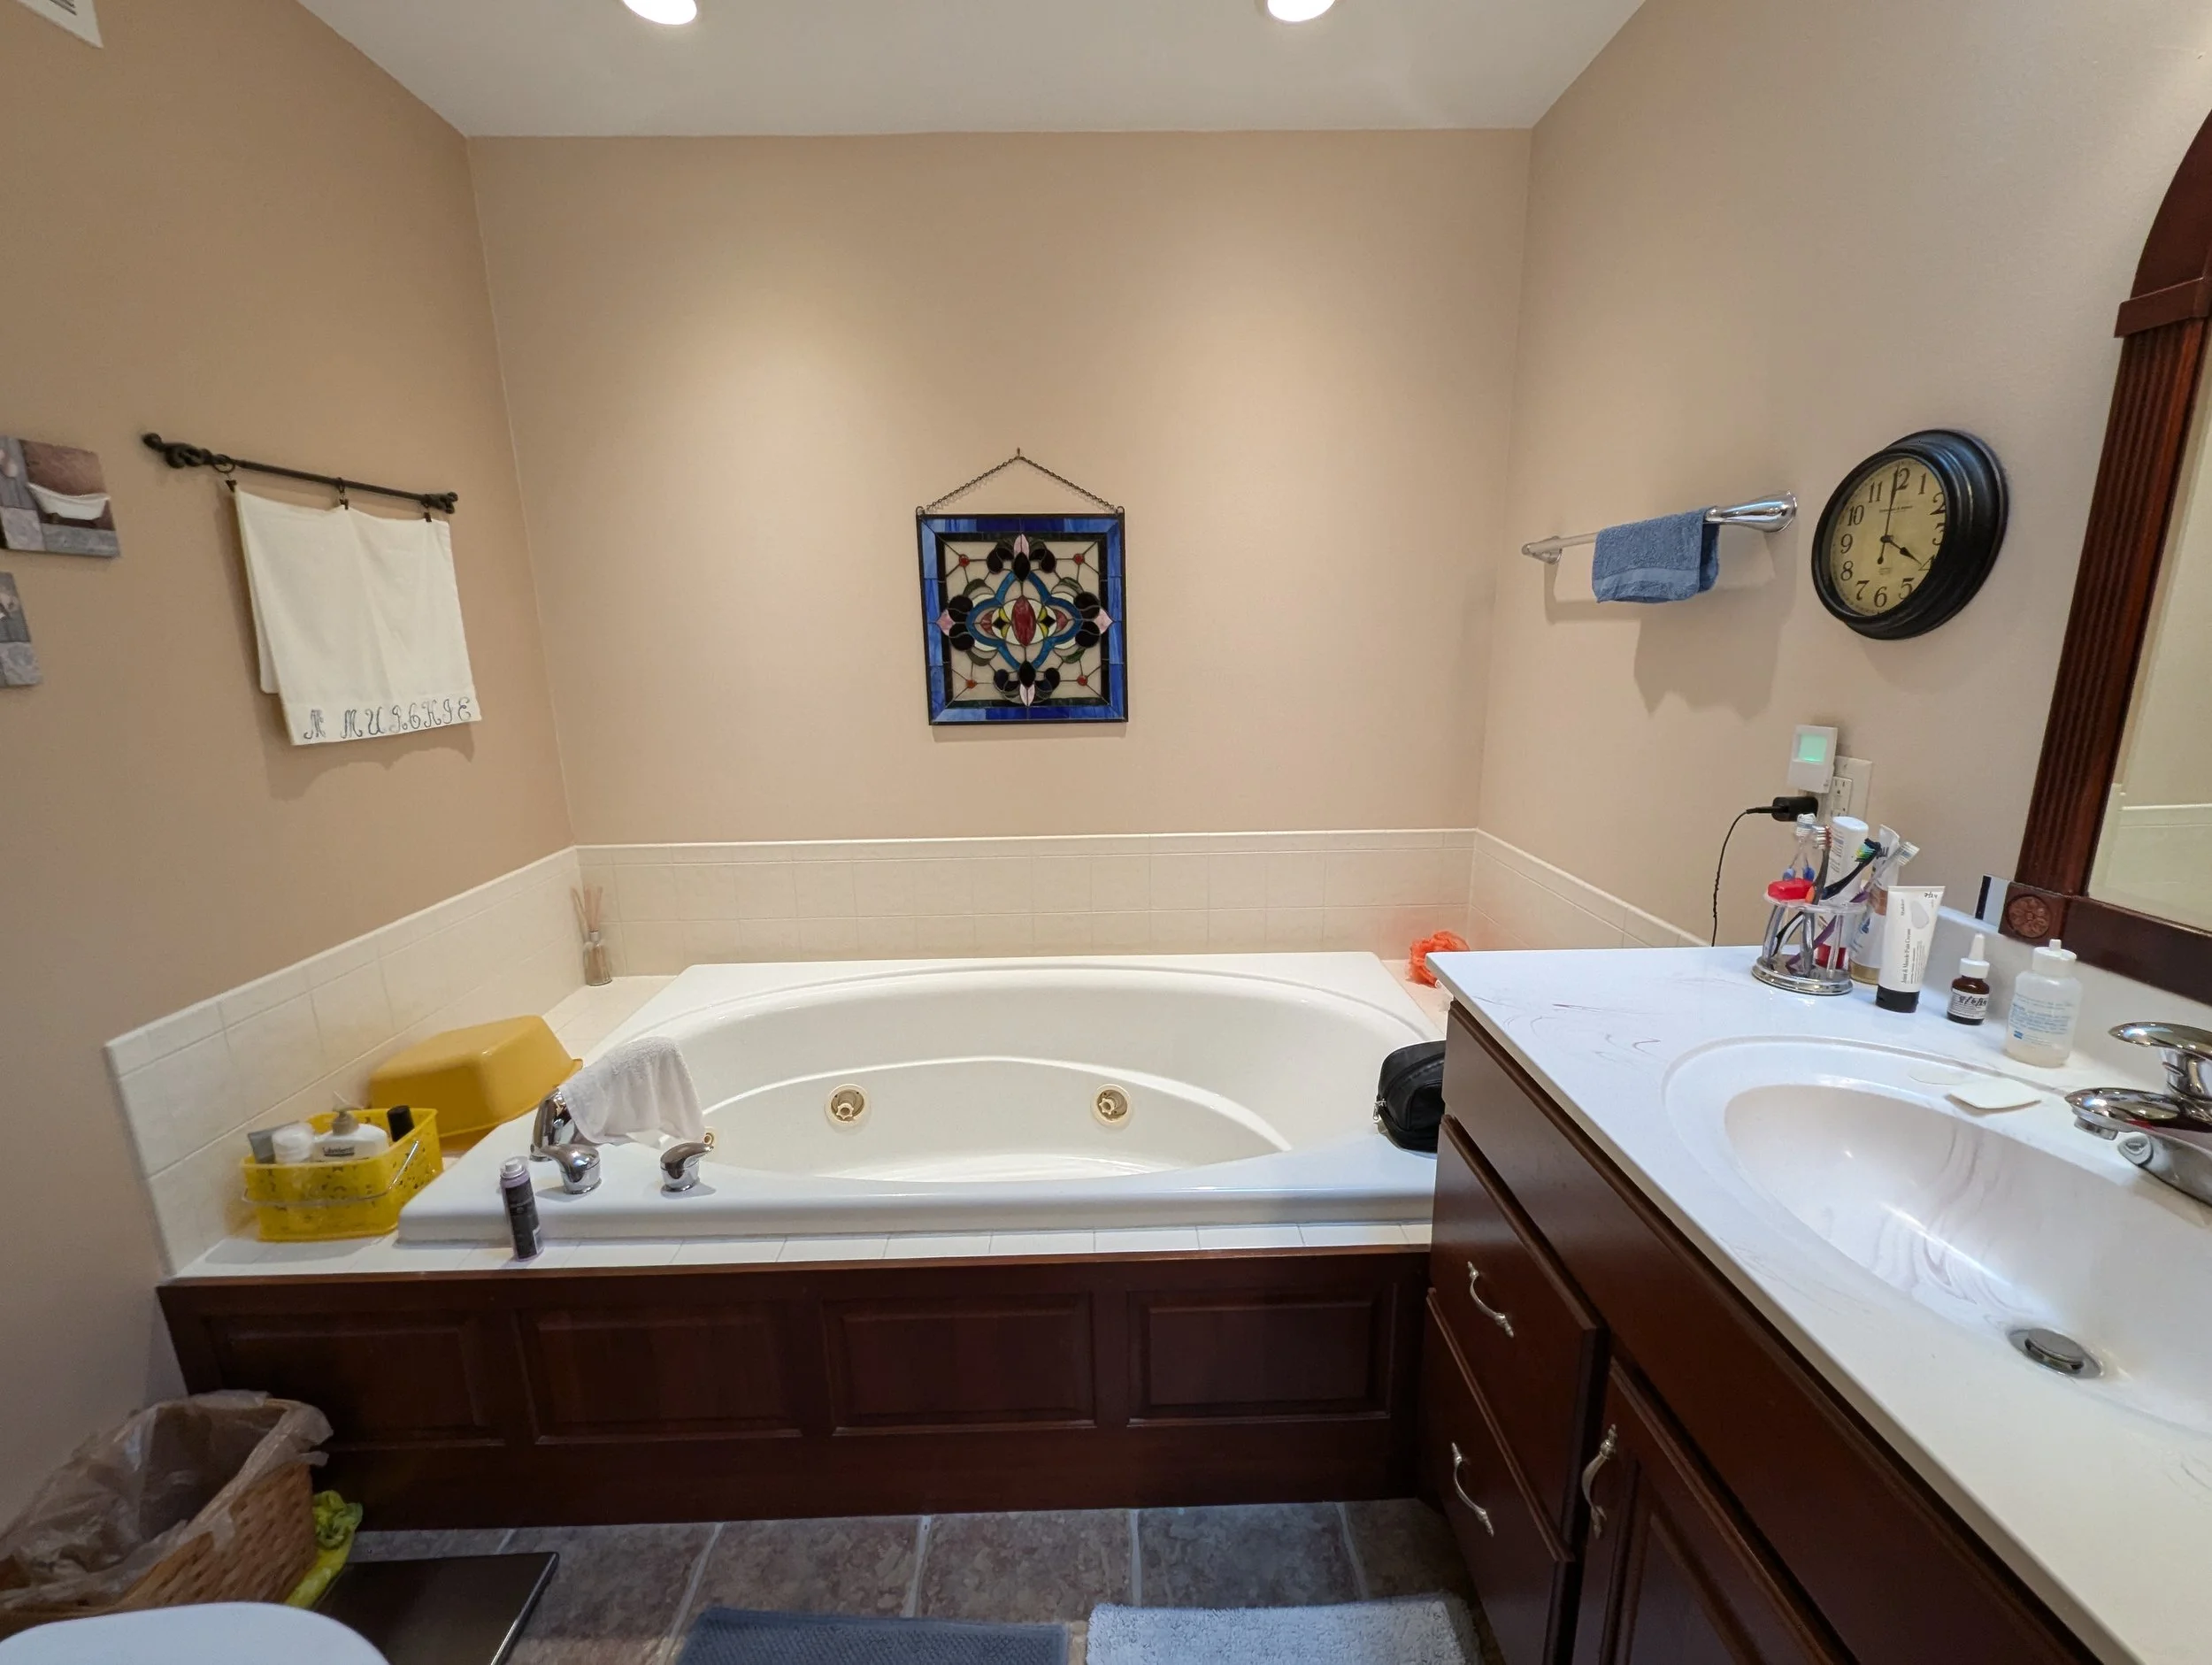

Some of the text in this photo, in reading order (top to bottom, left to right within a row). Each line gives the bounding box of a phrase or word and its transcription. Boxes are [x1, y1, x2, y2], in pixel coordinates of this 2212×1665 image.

[1868, 480, 1883, 503] 11
[1918, 472, 1927, 495] 1
[1847, 504, 1865, 526] 10
[1929, 491, 1946, 516] 2
[1840, 533, 1854, 554] 9
[1932, 522, 1946, 547] 3
[1840, 560, 1854, 581] 8
[1917, 554, 1935, 572] 4
[1855, 579, 1870, 602] 7
[1873, 586, 1888, 608] 6
[1898, 577, 1915, 600] 5
